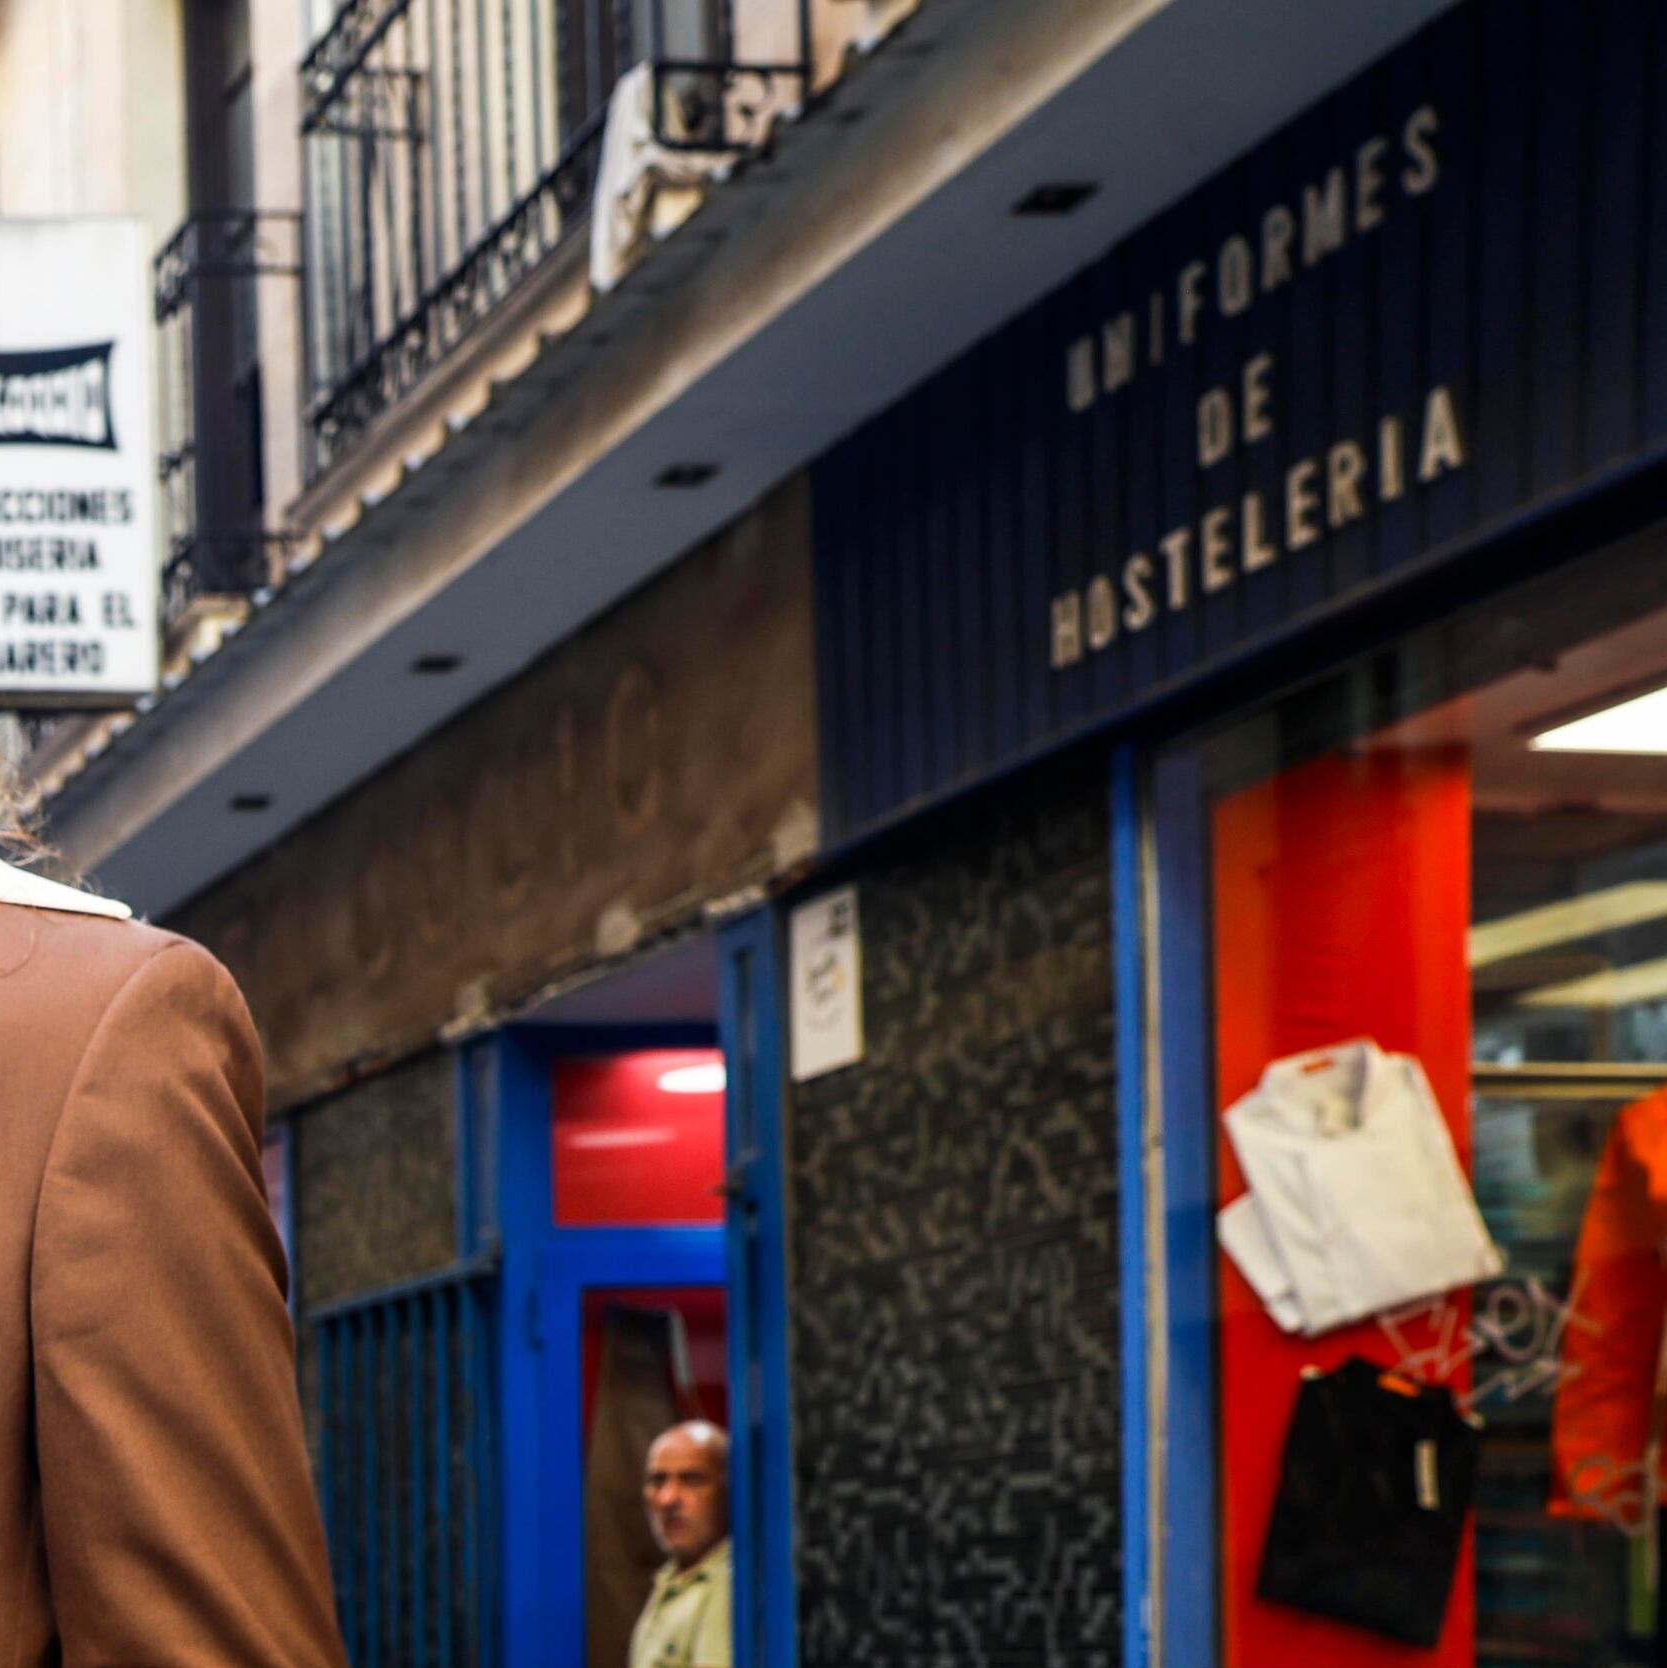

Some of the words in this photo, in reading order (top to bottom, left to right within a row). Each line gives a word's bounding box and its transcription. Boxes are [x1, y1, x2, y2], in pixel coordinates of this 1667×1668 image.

[1069, 105, 1438, 412] UNIFORMES
[1196, 353, 1271, 468] DE
[2, 591, 80, 625] PARA
[101, 592, 136, 628] EL
[1050, 386, 1464, 669] HOSTELERIA
